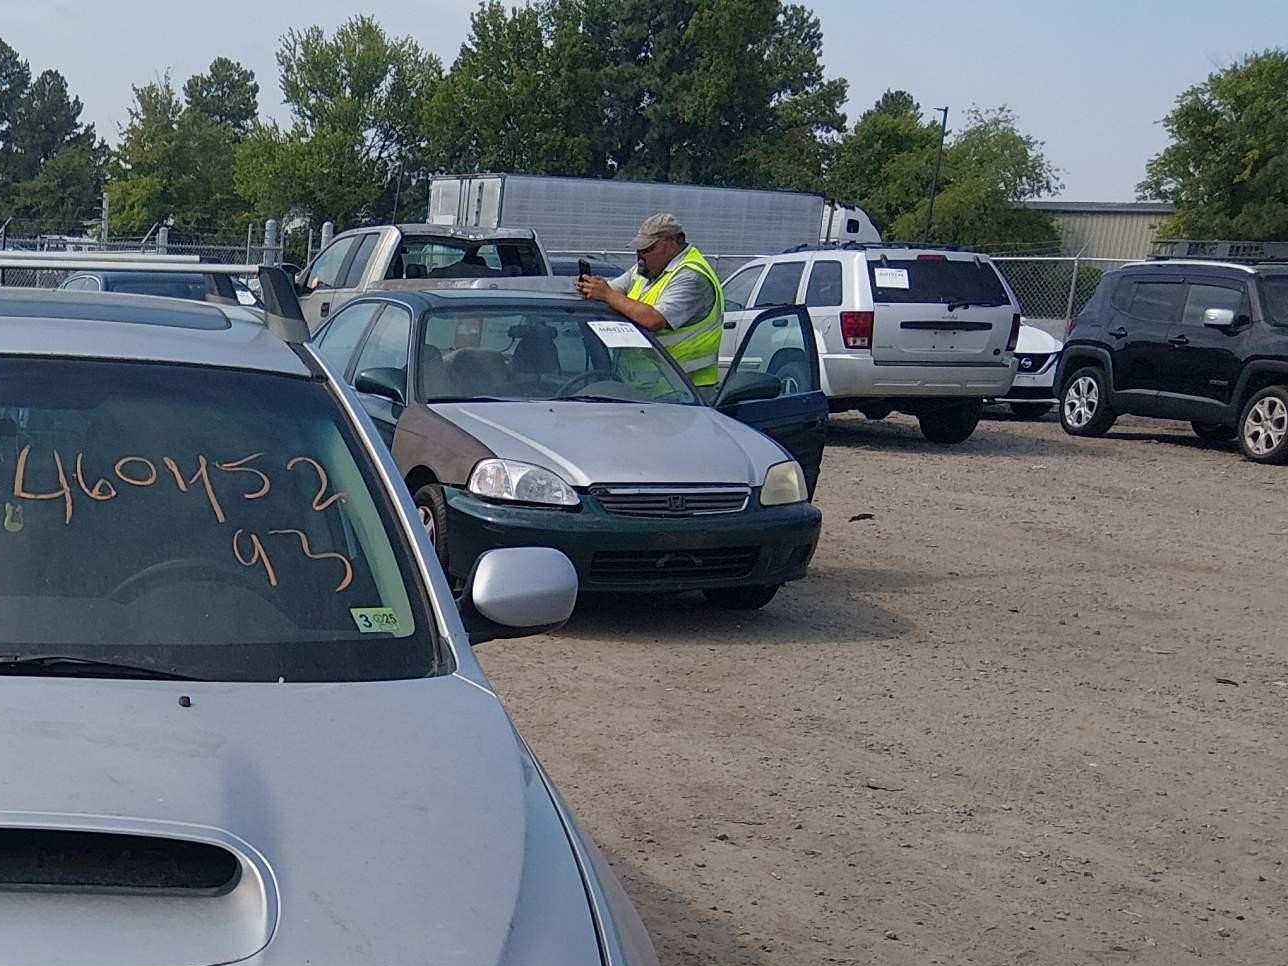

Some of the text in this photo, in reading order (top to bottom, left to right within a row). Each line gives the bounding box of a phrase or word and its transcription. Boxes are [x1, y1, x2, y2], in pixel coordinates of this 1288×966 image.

[231, 527, 354, 592] 93
[358, 613, 398, 628] 3 25
